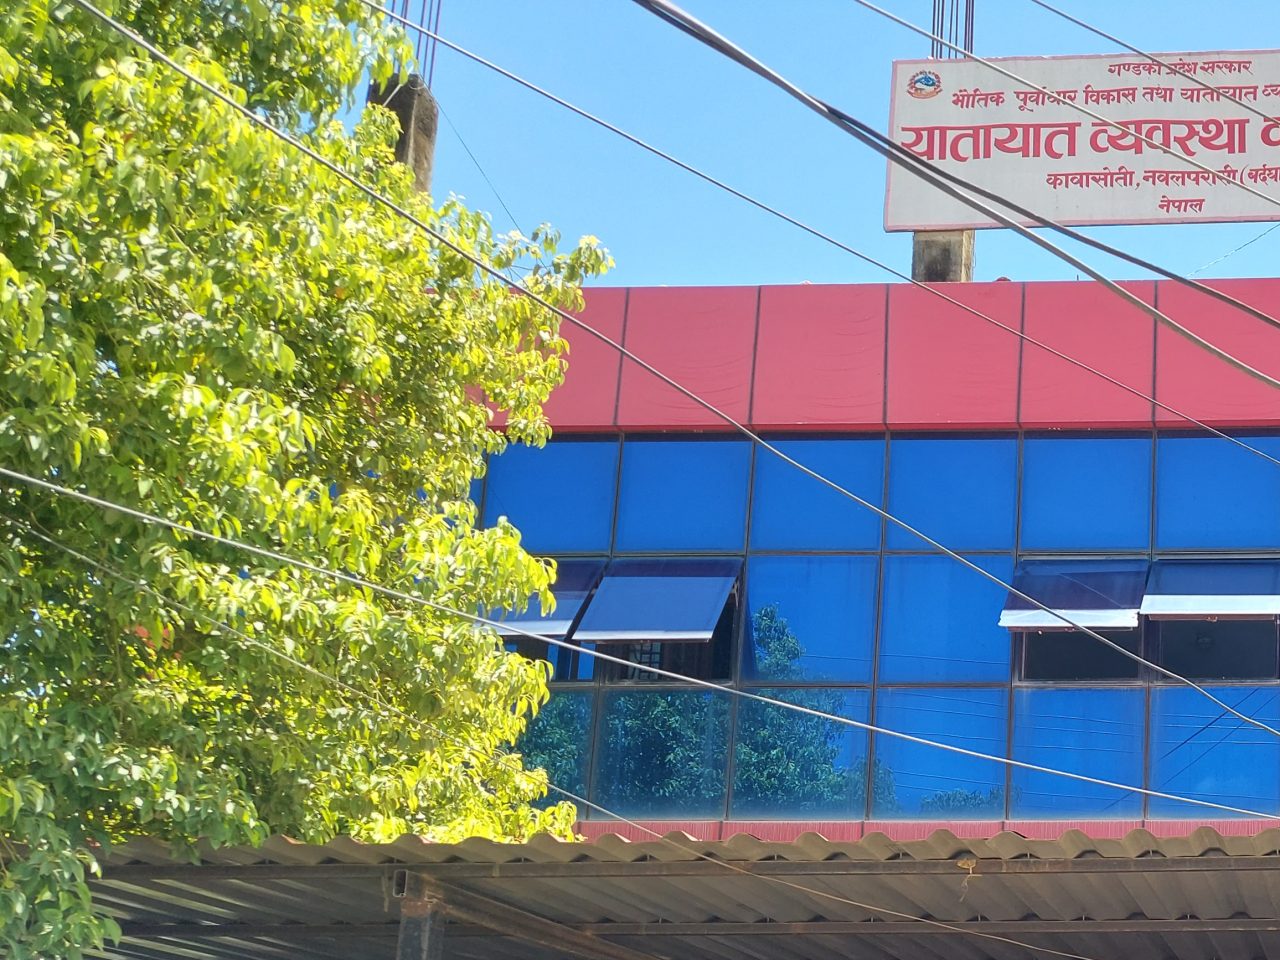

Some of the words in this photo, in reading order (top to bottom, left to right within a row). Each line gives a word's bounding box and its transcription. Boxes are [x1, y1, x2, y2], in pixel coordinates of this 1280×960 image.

[901, 121, 1082, 162] यातायात
[1089, 117, 1250, 157] व्यवस्था
[1158, 194, 1205, 214] नेपाल
